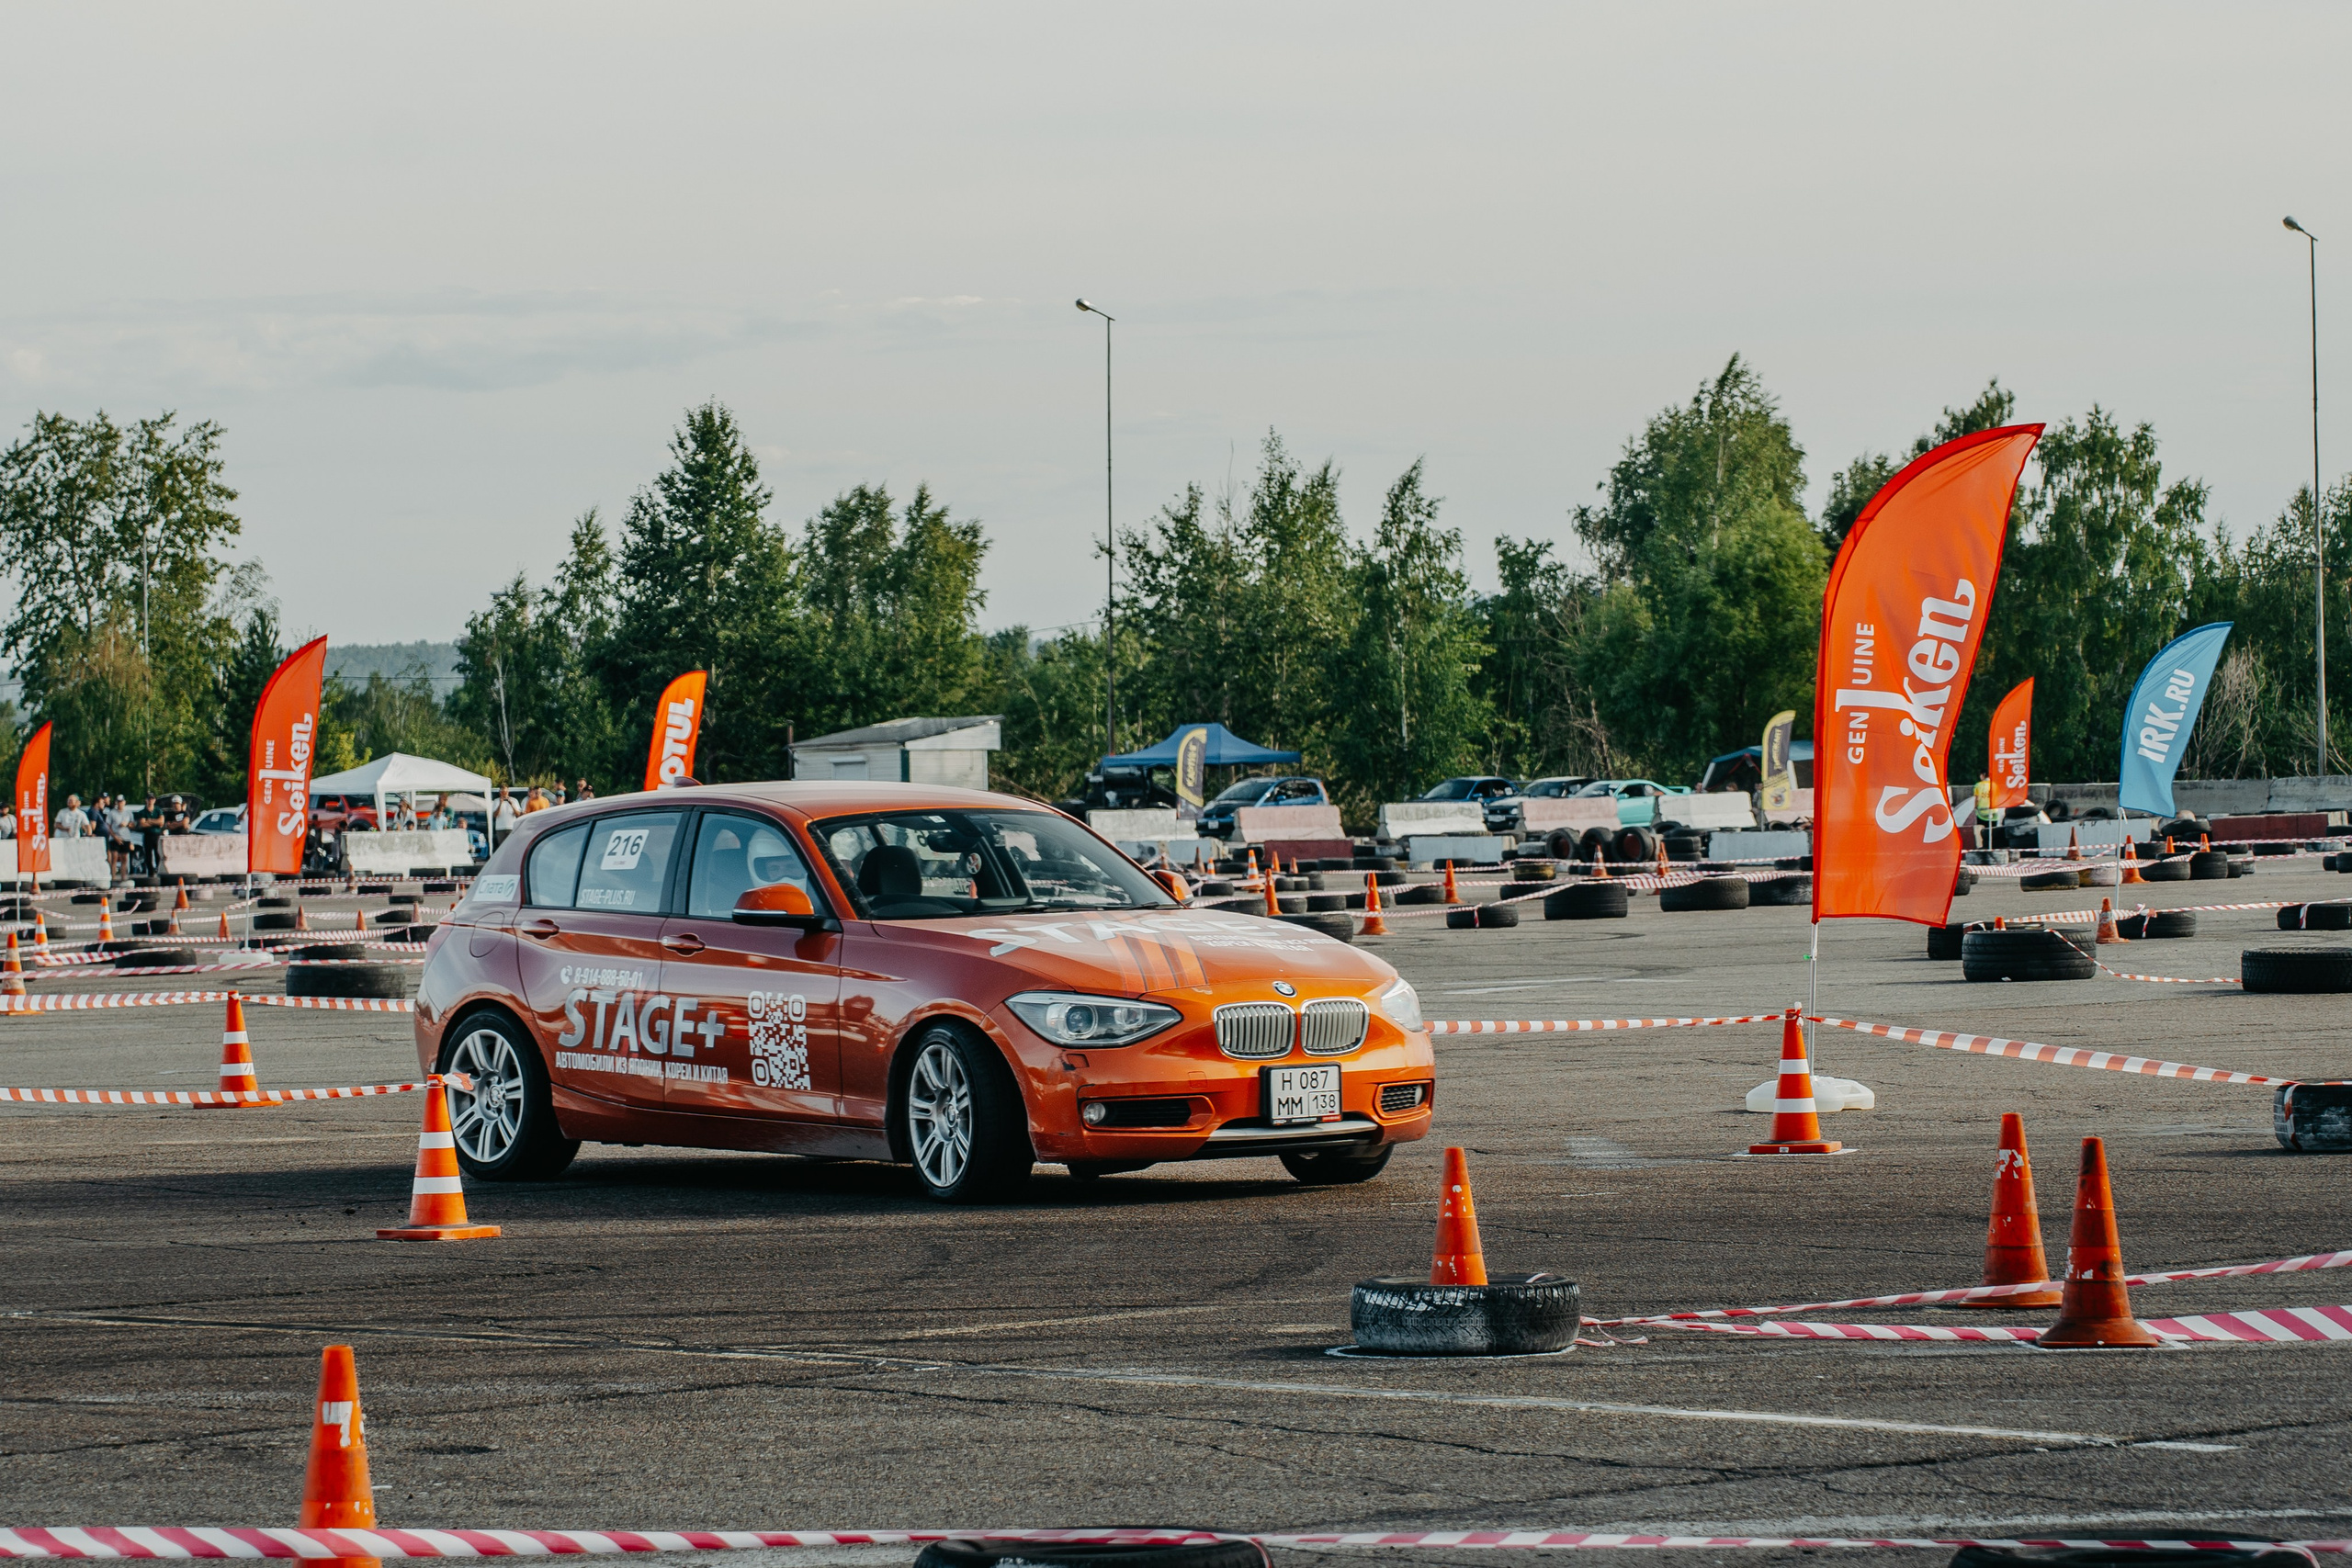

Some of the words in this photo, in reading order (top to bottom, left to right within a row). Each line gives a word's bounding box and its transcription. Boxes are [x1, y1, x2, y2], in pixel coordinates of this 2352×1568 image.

[657, 697, 695, 790] OTUL
[1835, 579, 1975, 843] Seiken
[2137, 669, 2195, 763] IRK.RU
[258, 713, 313, 838] Seiken
[1995, 720, 2027, 789] Seiken
[21, 773, 46, 852] Seiken
[606, 835, 643, 856] 216
[580, 888, 637, 906] STAGE-PLUS.RU
[573, 967, 643, 988] 8-914-888-50-01
[559, 987, 725, 1057] STAGE+
[555, 1051, 615, 1073] АВТОМОБИЛИ
[615, 1056, 628, 1074] ИЗ
[664, 1061, 692, 1080] КОРЕИ
[693, 1064, 700, 1082] И
[700, 1065, 729, 1084] КИТАЯ
[1282, 1072, 1293, 1090] Н
[1299, 1070, 1329, 1089] 087
[1278, 1096, 1303, 1115] ММ
[1312, 1094, 1336, 1109] 138
